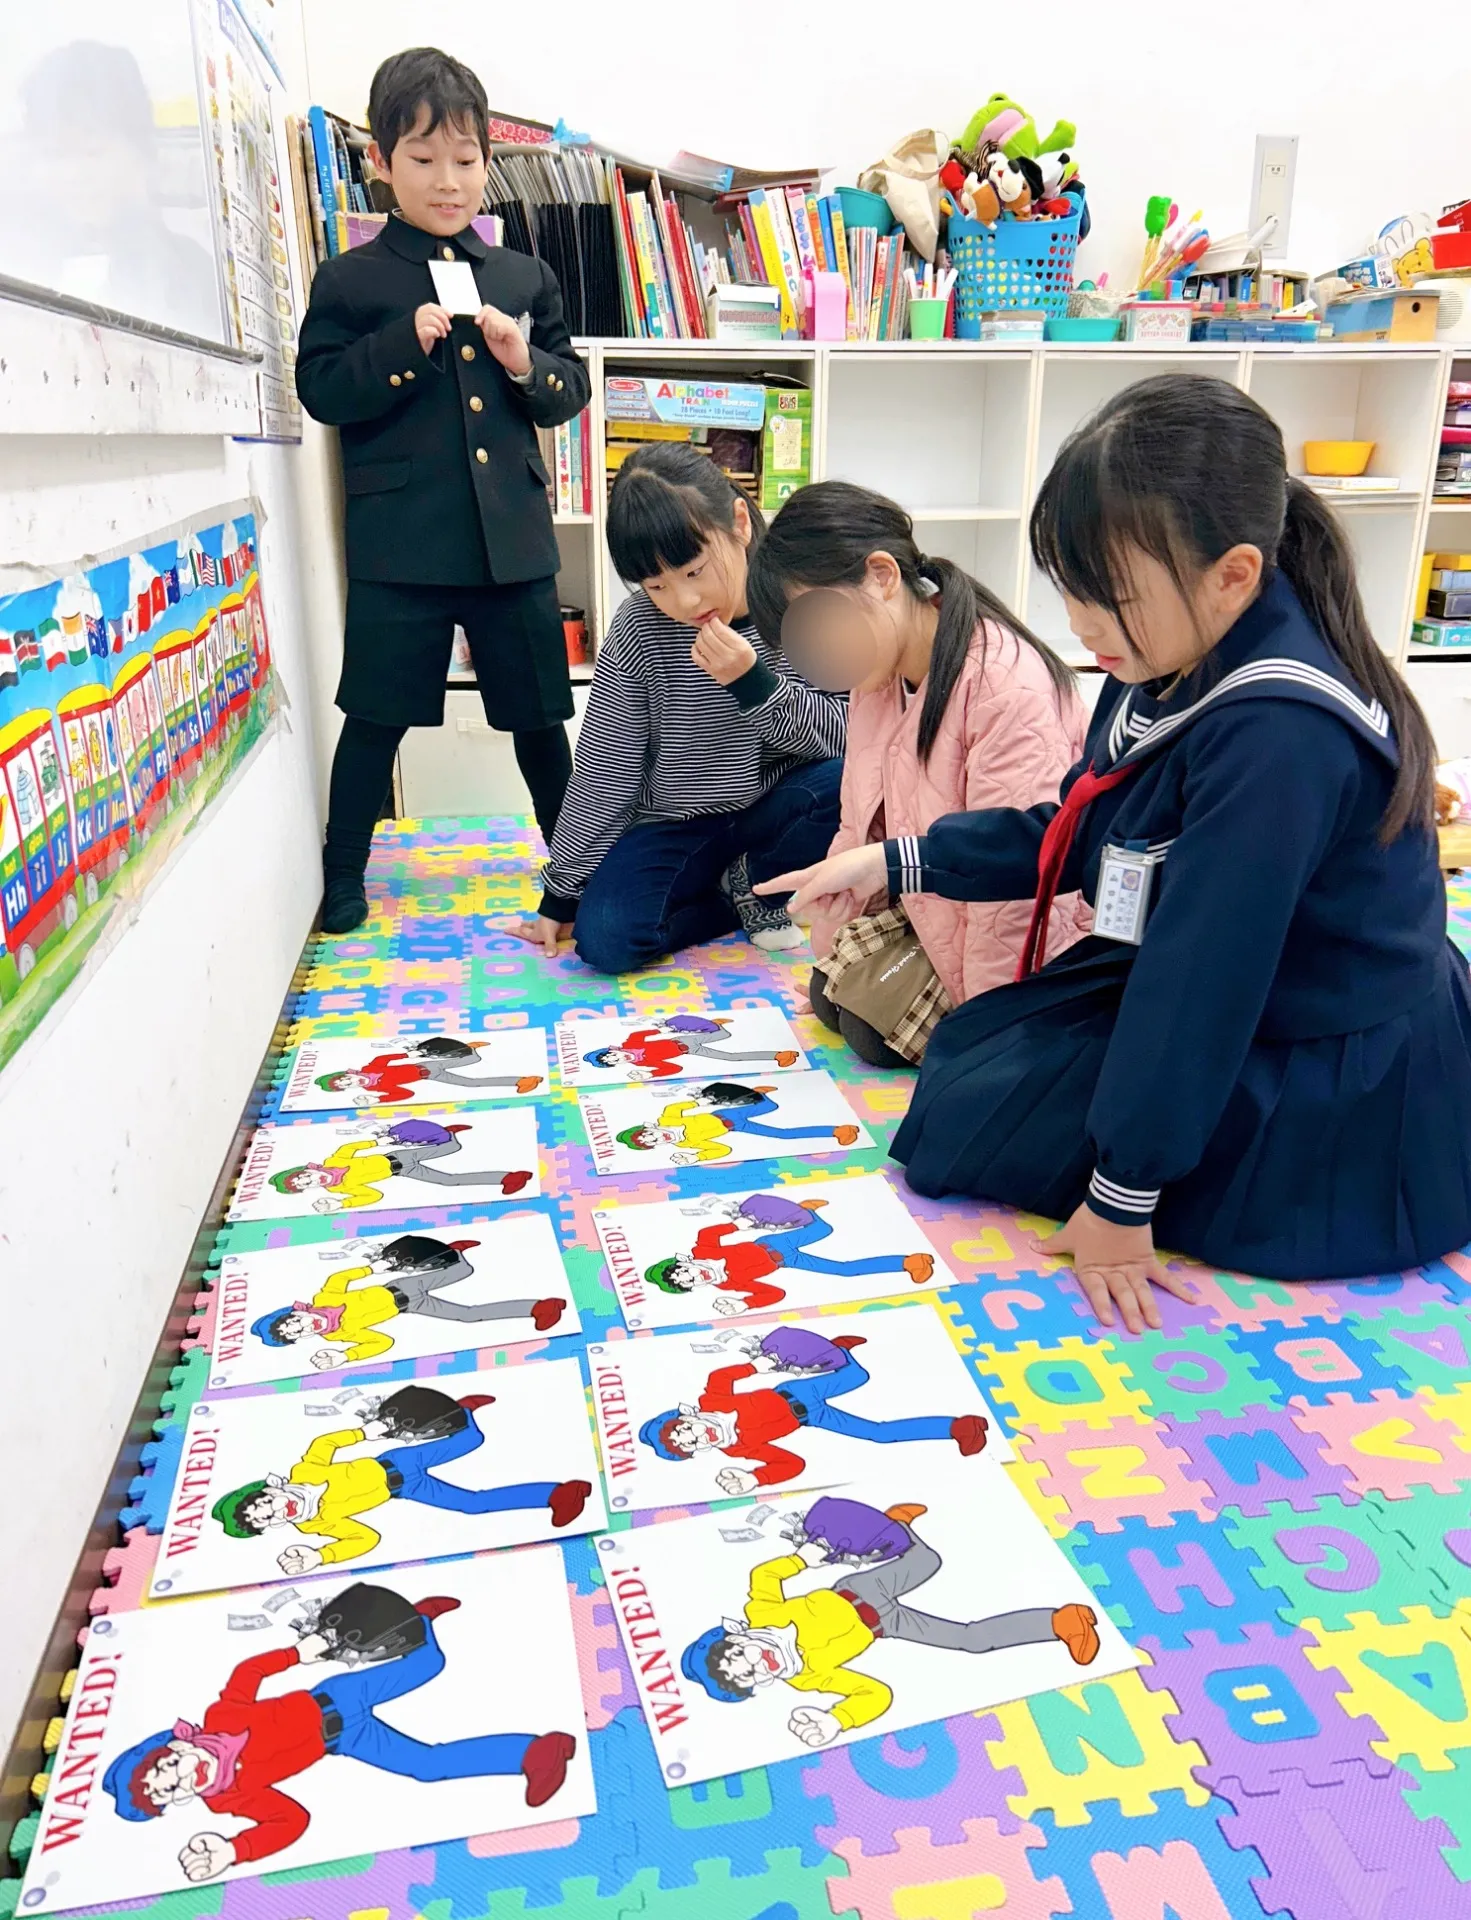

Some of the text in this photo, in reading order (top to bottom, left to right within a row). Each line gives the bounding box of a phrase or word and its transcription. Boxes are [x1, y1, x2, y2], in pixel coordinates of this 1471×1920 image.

[657, 382, 730, 399] Alphabet
[681, 397, 711, 406] TRAIN
[188, 721, 199, 743] Ss
[76, 814, 92, 847] Kk
[5, 879, 29, 922] Hh
[413, 919, 455, 933] K
[401, 988, 449, 1006] G
[484, 986, 530, 1004] A
[398, 1017, 447, 1035] H
[483, 1011, 530, 1030] B
[287, 1049, 320, 1098] WANTED!
[561, 1030, 580, 1075] WANTED!
[585, 1104, 616, 1160] WANTED!
[237, 1141, 276, 1203] WANTED!
[602, 1224, 648, 1308] WANTED!
[218, 1272, 249, 1363] WANTED!
[1274, 1337, 1363, 1384] B
[1389, 1324, 1471, 1368] A
[1152, 1350, 1229, 1394] C
[596, 1364, 639, 1478] WANTED!
[166, 1427, 220, 1558] WANTED!
[1126, 1540, 1236, 1614] H
[611, 1565, 689, 1735] WANTED!
[1203, 1663, 1322, 1745] B
[1358, 1641, 1470, 1723] A
[1026, 1682, 1146, 1776] N
[41, 1653, 123, 1854] WANTED!
